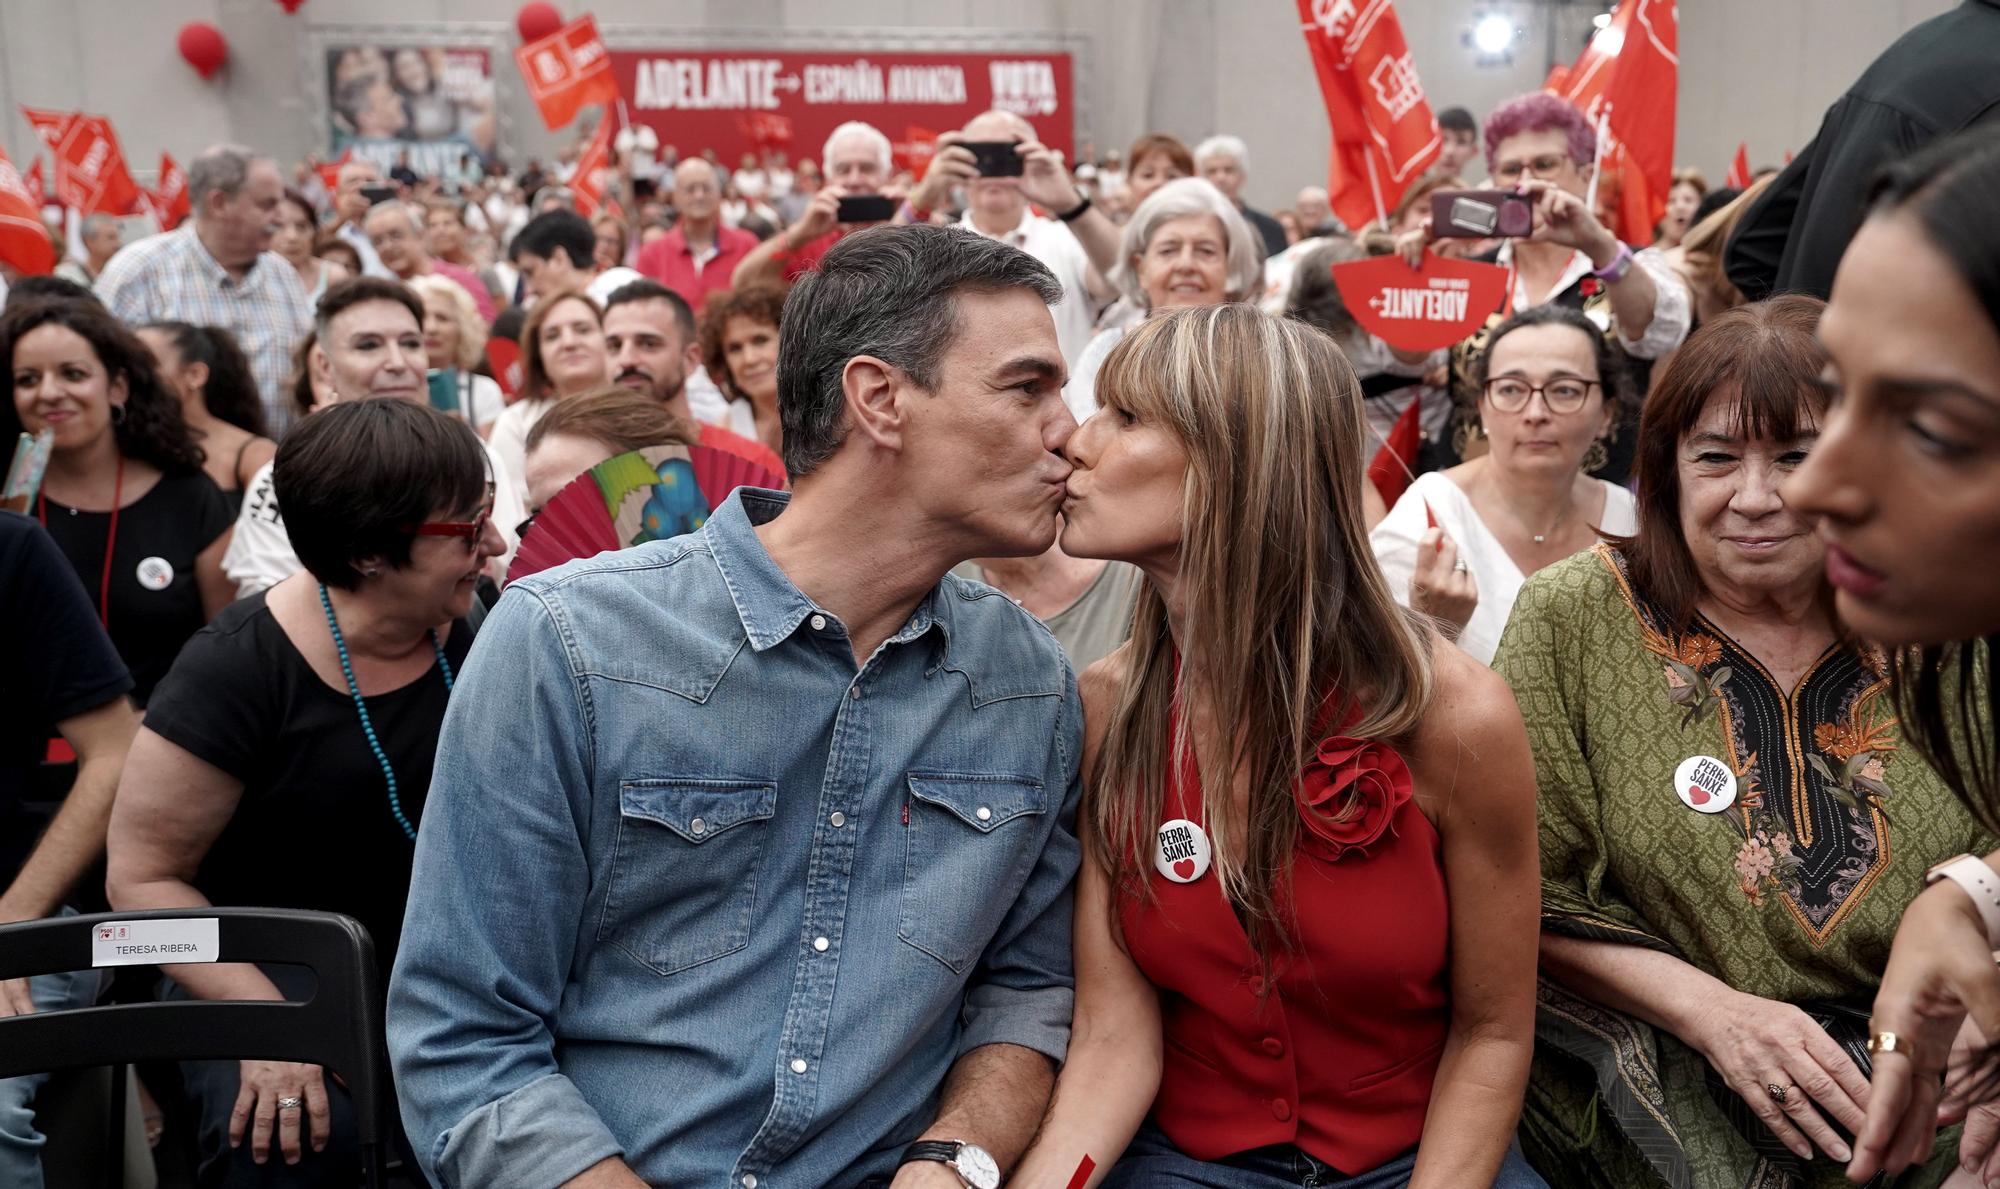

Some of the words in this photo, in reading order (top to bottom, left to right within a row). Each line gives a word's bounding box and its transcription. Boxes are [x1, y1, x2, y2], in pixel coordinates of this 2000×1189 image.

[635, 58, 782, 109] ADELANTE
[803, 59, 885, 104] ESPAÑA
[887, 64, 967, 104] AVANZA
[988, 60, 1056, 98] VOTA
[1379, 287, 1469, 322] ADELANTE
[1689, 768, 1725, 796] SANXE
[1697, 758, 1729, 785] PERRA
[1159, 825, 1192, 848] PERRA
[1162, 840, 1196, 863] SANXE
[116, 945, 158, 955] TERESA
[160, 943, 198, 953] RIBERA
